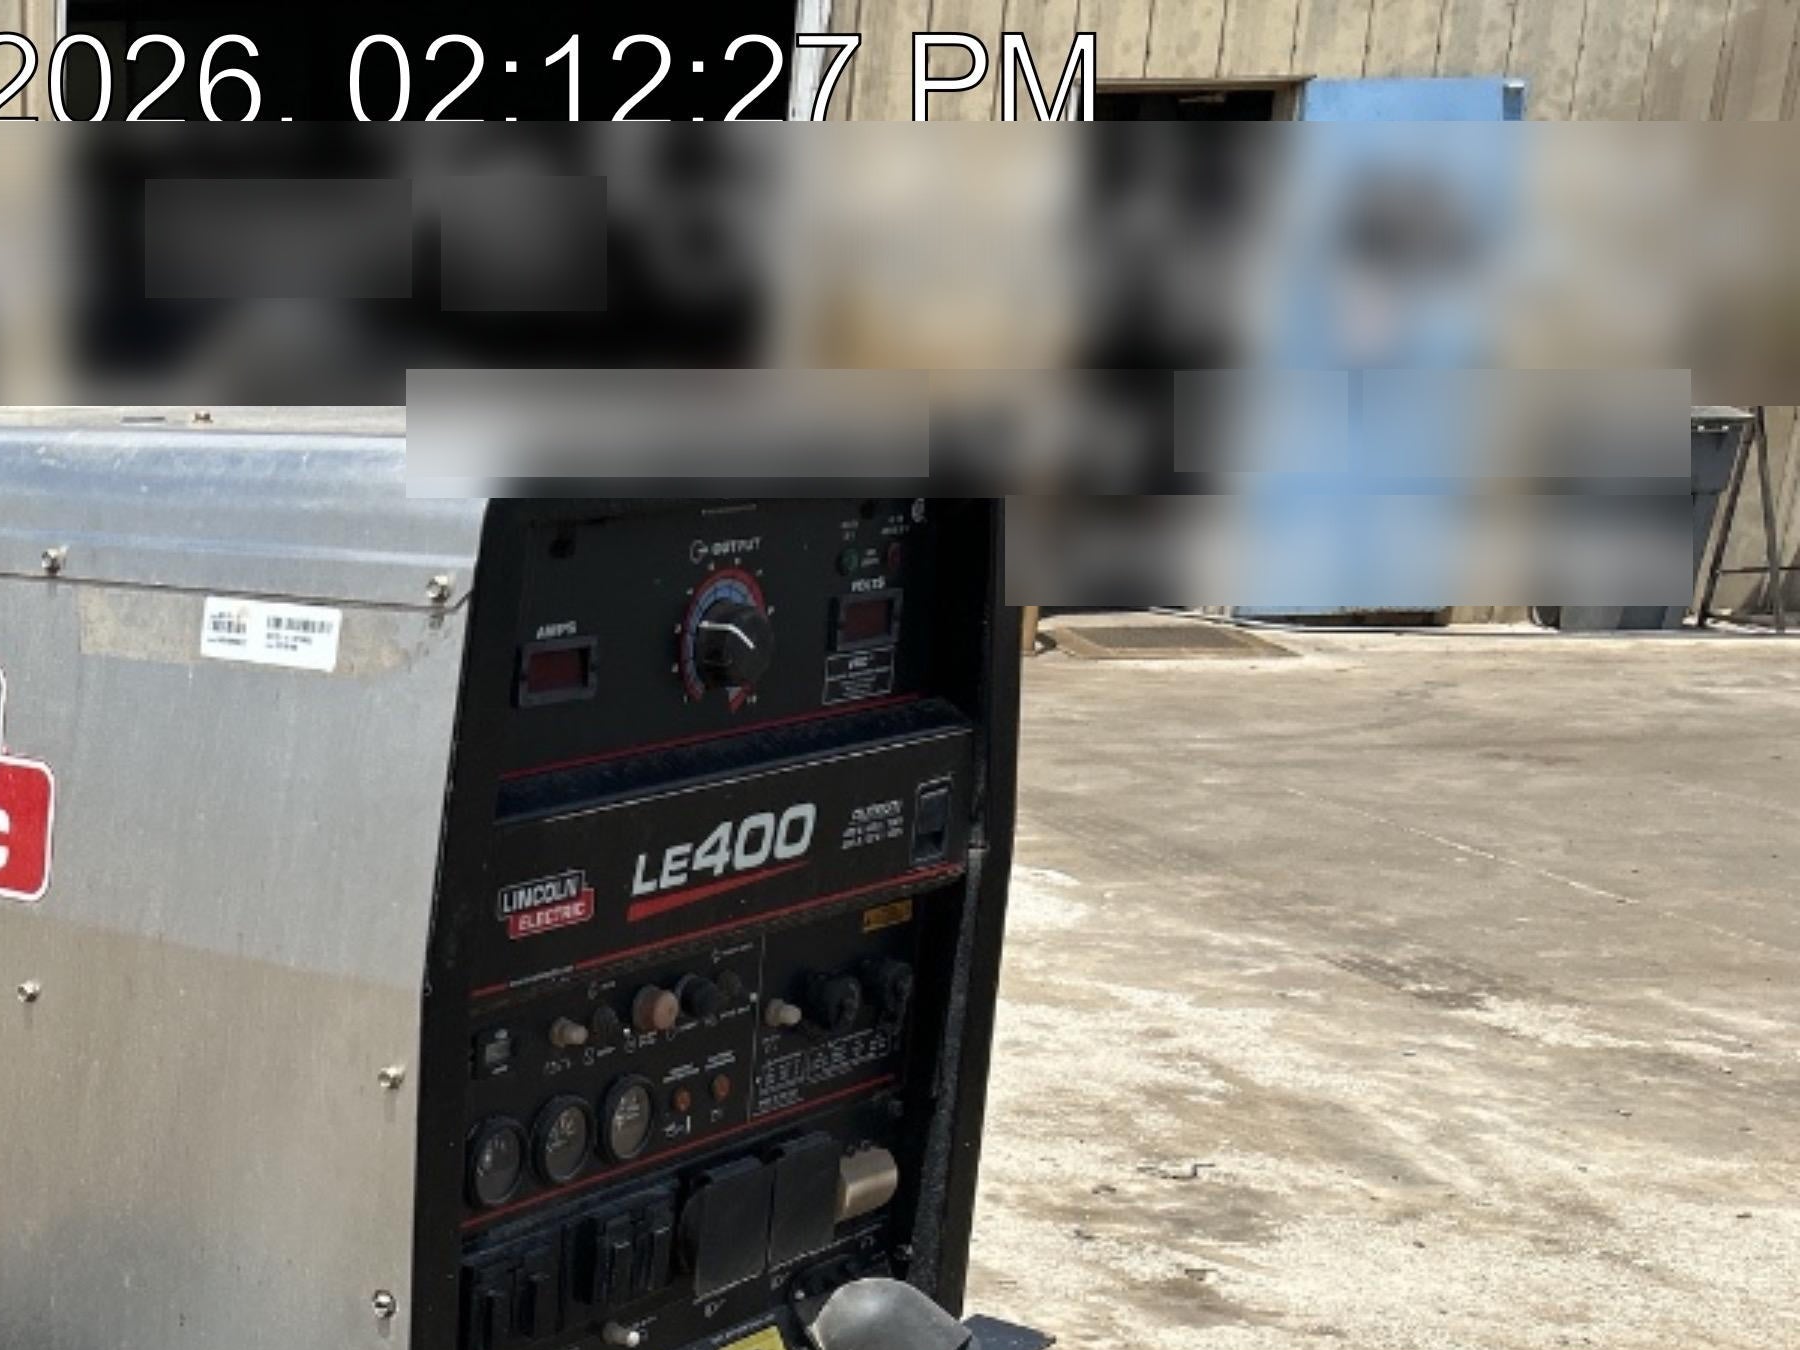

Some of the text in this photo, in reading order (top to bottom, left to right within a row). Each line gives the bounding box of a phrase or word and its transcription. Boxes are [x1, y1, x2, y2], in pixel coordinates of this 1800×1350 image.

[632, 803, 816, 895] LE400
[502, 875, 581, 913] LINCOLN
[518, 902, 586, 931] ELECTRIC
